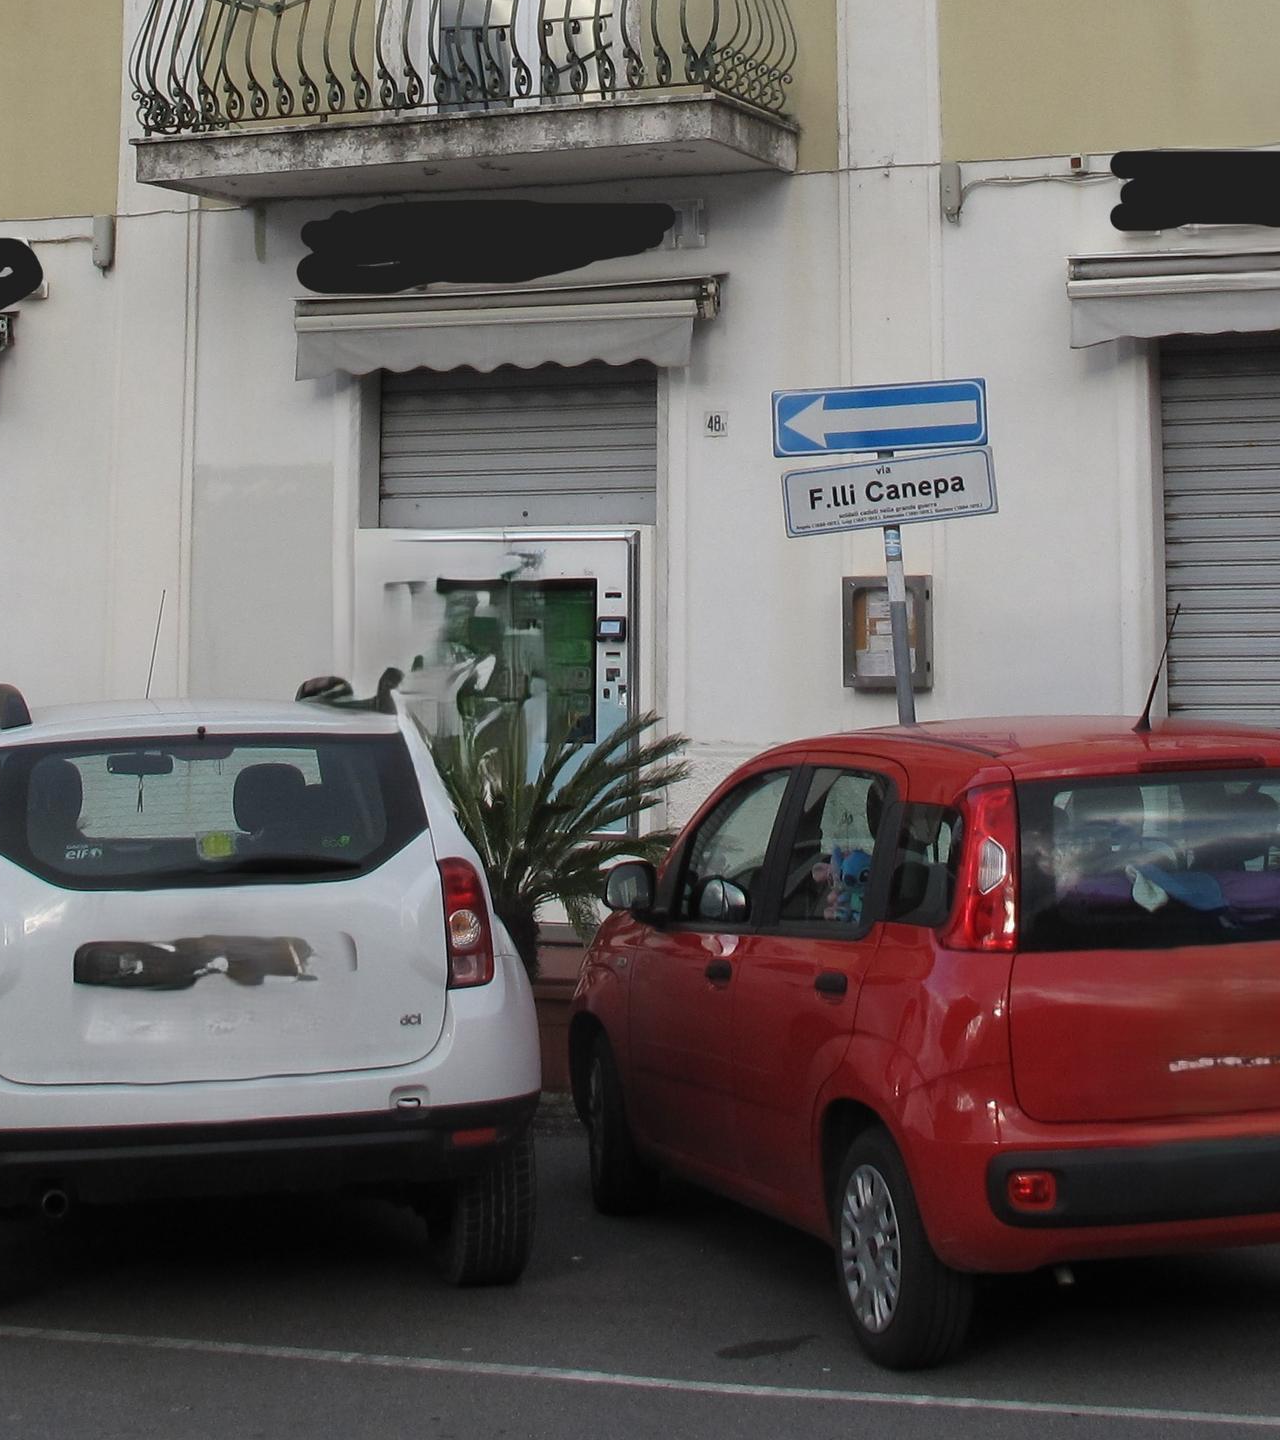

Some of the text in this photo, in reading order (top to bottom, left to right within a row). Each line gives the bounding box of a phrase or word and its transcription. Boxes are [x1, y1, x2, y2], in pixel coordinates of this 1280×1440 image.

[875, 465, 891, 476] via
[808, 475, 965, 510] F.lli Canepa
[65, 849, 89, 860] elf
